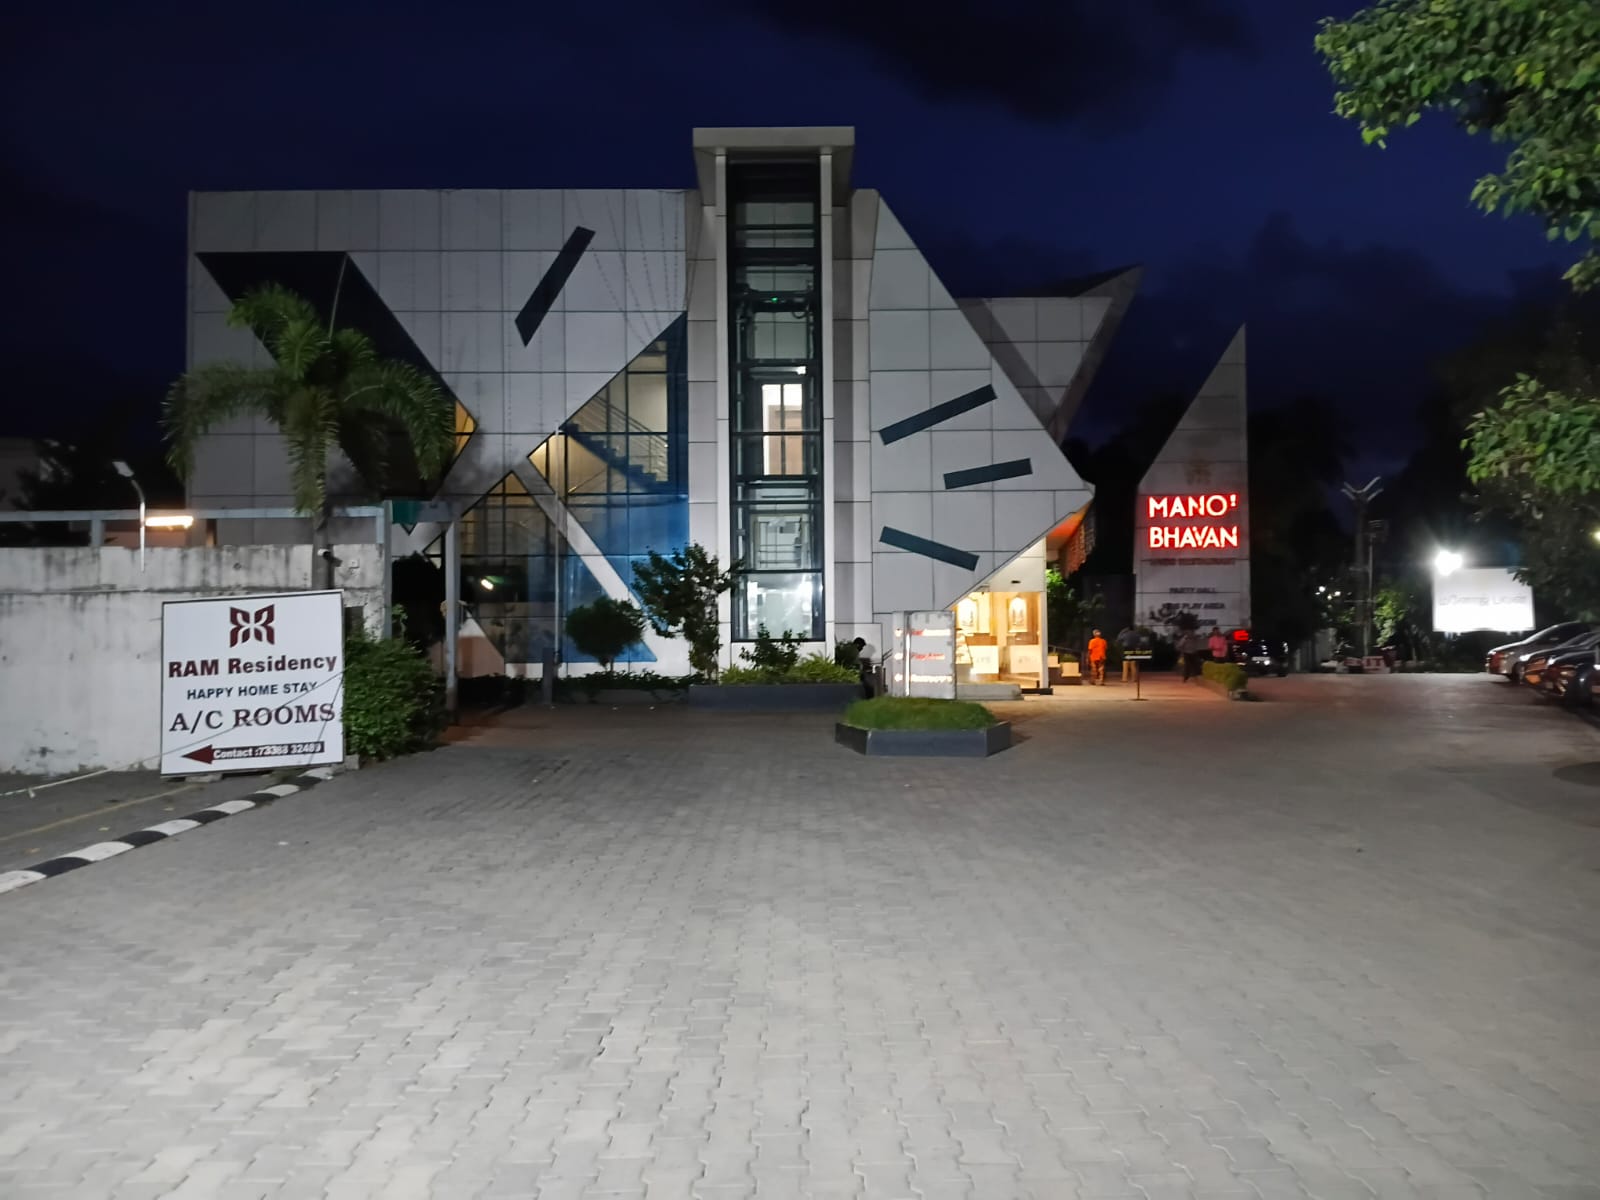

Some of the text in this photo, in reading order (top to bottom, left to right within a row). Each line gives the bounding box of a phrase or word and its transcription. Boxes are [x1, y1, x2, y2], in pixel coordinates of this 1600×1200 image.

[1149, 526, 1238, 548] BHAVAN
[169, 655, 337, 678] RAM Residency
[187, 681, 317, 700] HAPPY HOME STAY
[169, 703, 336, 734] A/C ROOMS
[213, 747, 254, 760] Contact
